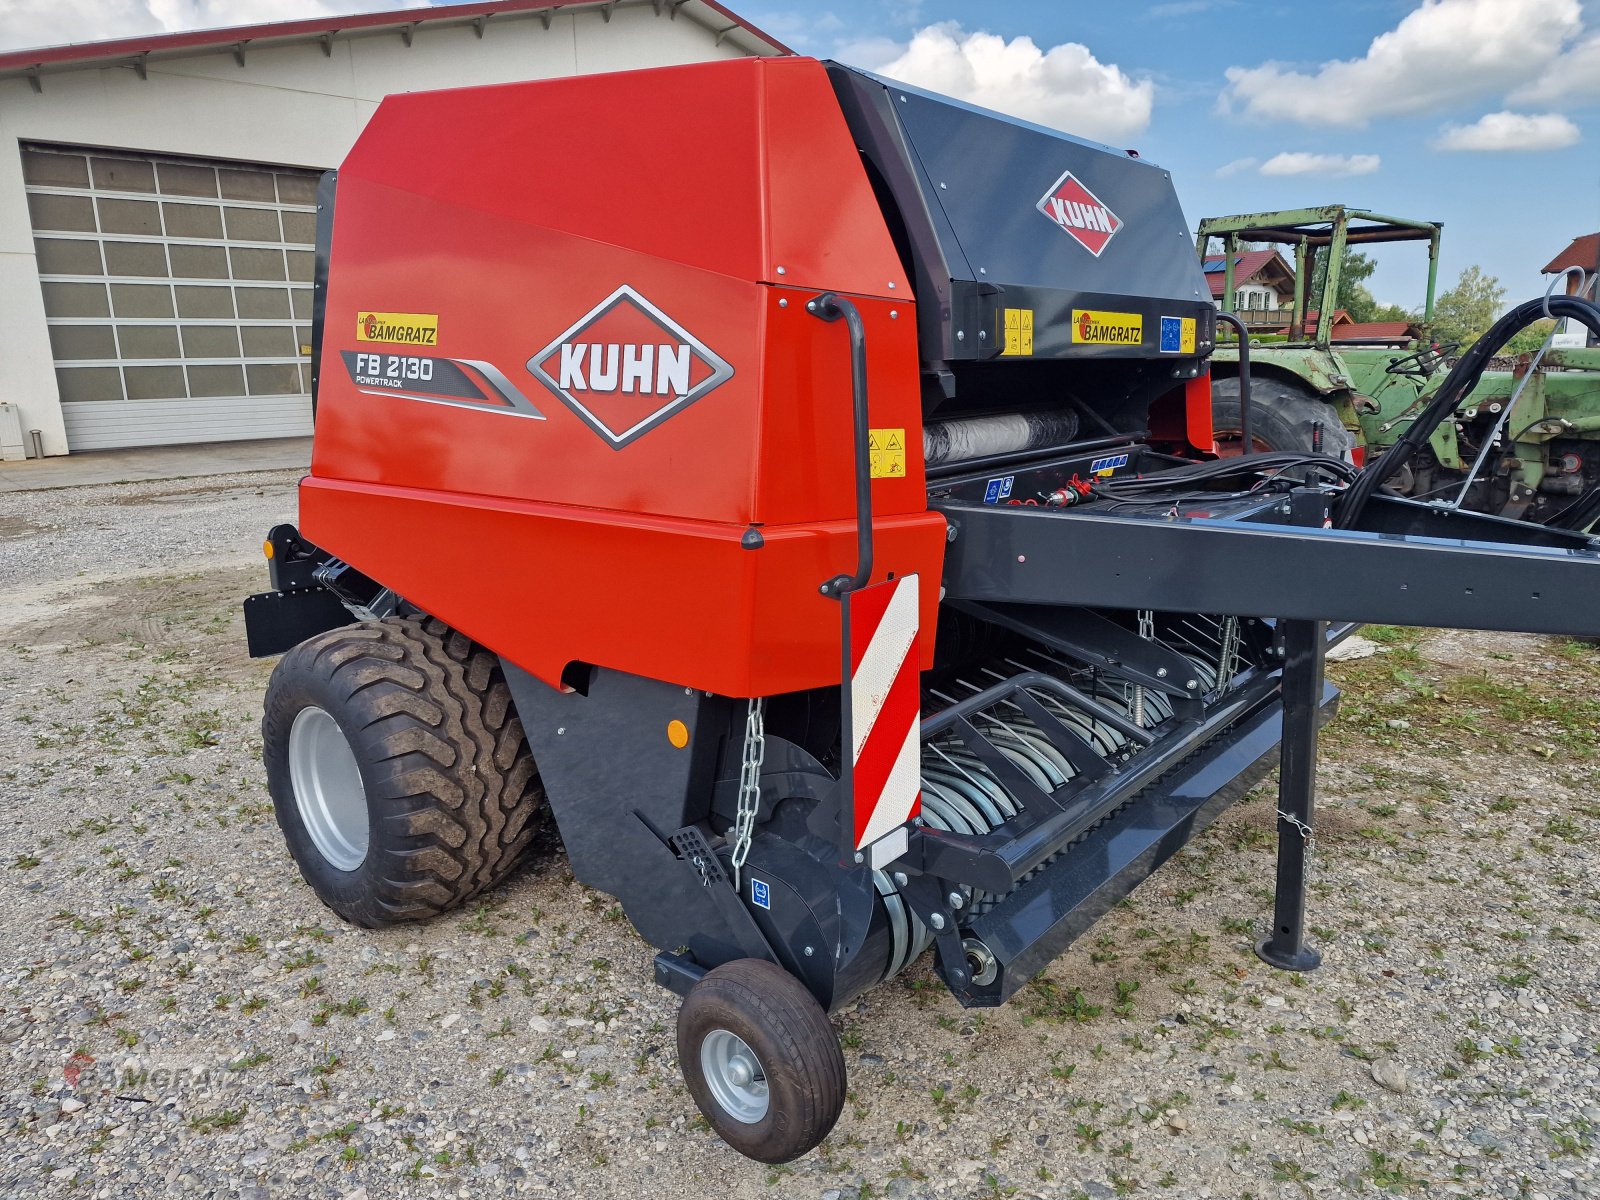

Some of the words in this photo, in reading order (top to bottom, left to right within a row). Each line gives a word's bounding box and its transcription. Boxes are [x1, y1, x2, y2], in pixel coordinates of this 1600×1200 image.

[1050, 196, 1113, 234] KUHN
[368, 325, 436, 343] BAMGRATZ
[1084, 325, 1140, 343] BAMGRATZ
[356, 353, 380, 376] FB
[386, 356, 433, 381] 2130
[558, 343, 691, 397] KUHN
[356, 375, 403, 388] POWERTRACK
